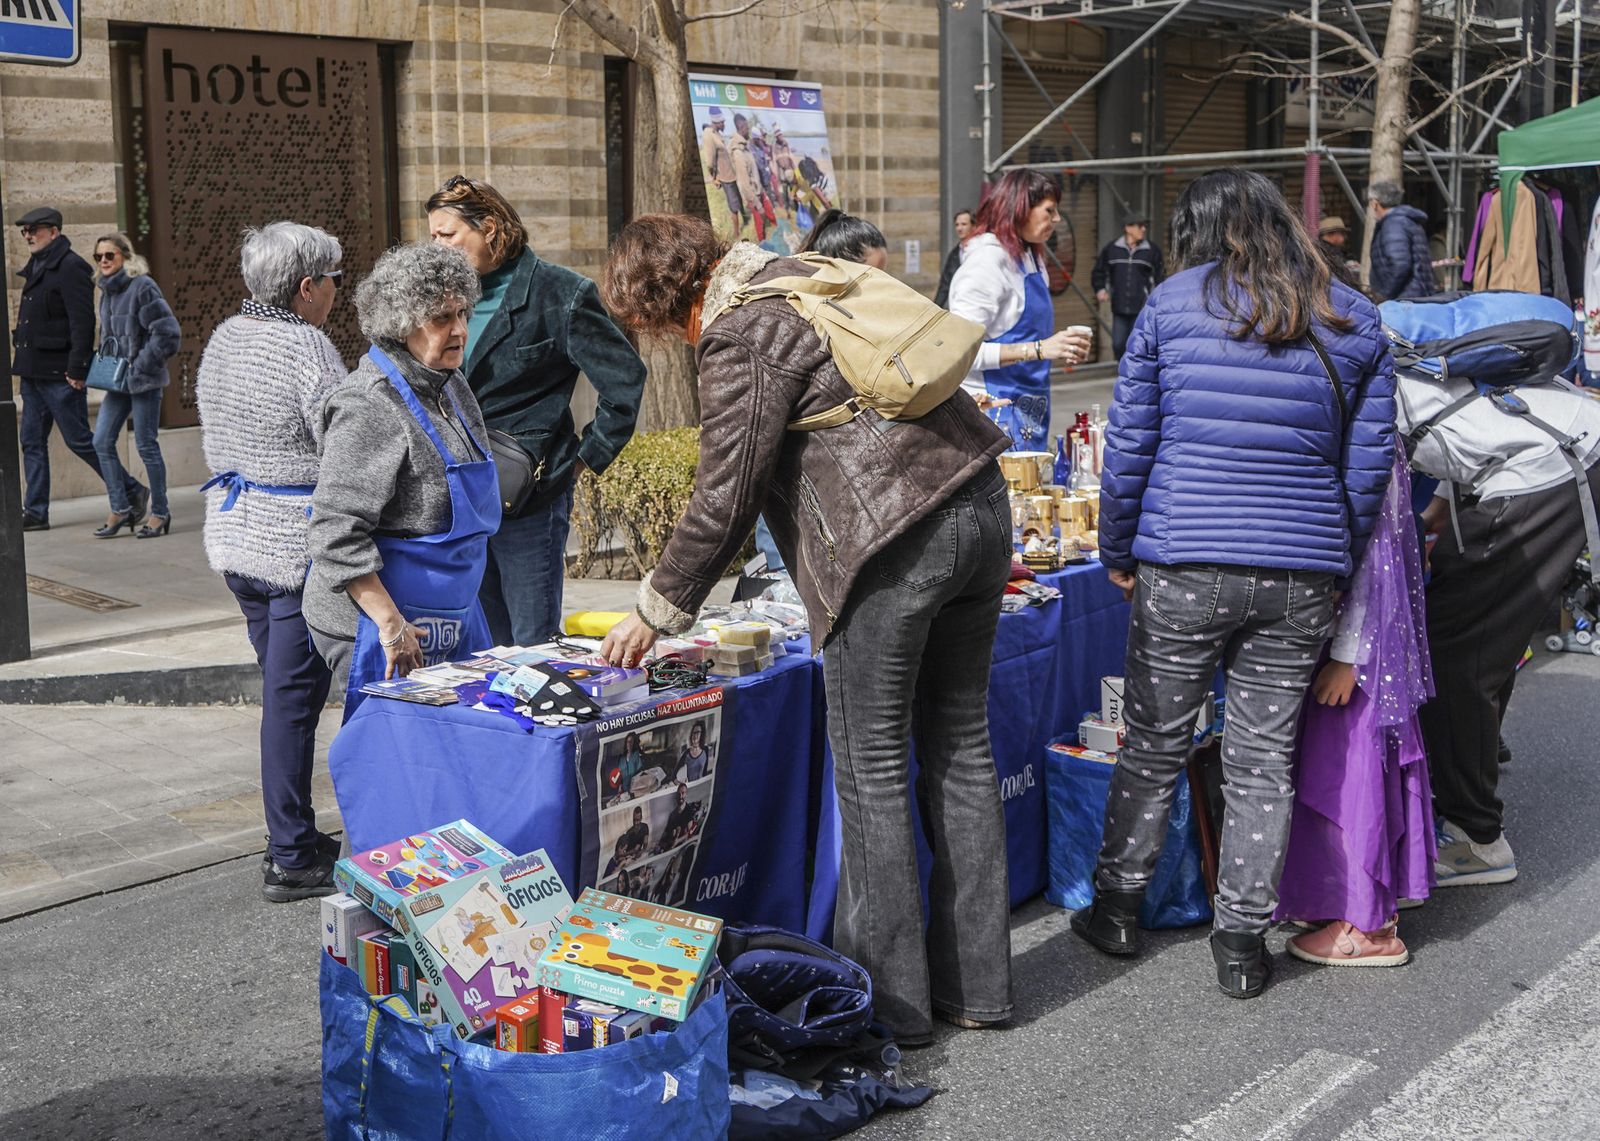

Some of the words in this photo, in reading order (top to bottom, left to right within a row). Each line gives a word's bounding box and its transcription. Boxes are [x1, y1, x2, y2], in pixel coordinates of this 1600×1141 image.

[162, 48, 327, 108] hotel
[595, 721, 609, 733] NO
[609, 718, 626, 730] HAY
[657, 705, 671, 717] HAZ
[672, 692, 723, 711] VOLUNTARIADO
[1110, 699, 1118, 723] OLI
[1001, 763, 1036, 802] CORJE
[506, 875, 563, 910] OFICIOS
[414, 941, 443, 987] OFICIOS
[463, 987, 483, 1006] 40
[573, 973, 598, 990] Primo
[599, 983, 626, 998] puzzle
[474, 1000, 492, 1013] piezas
